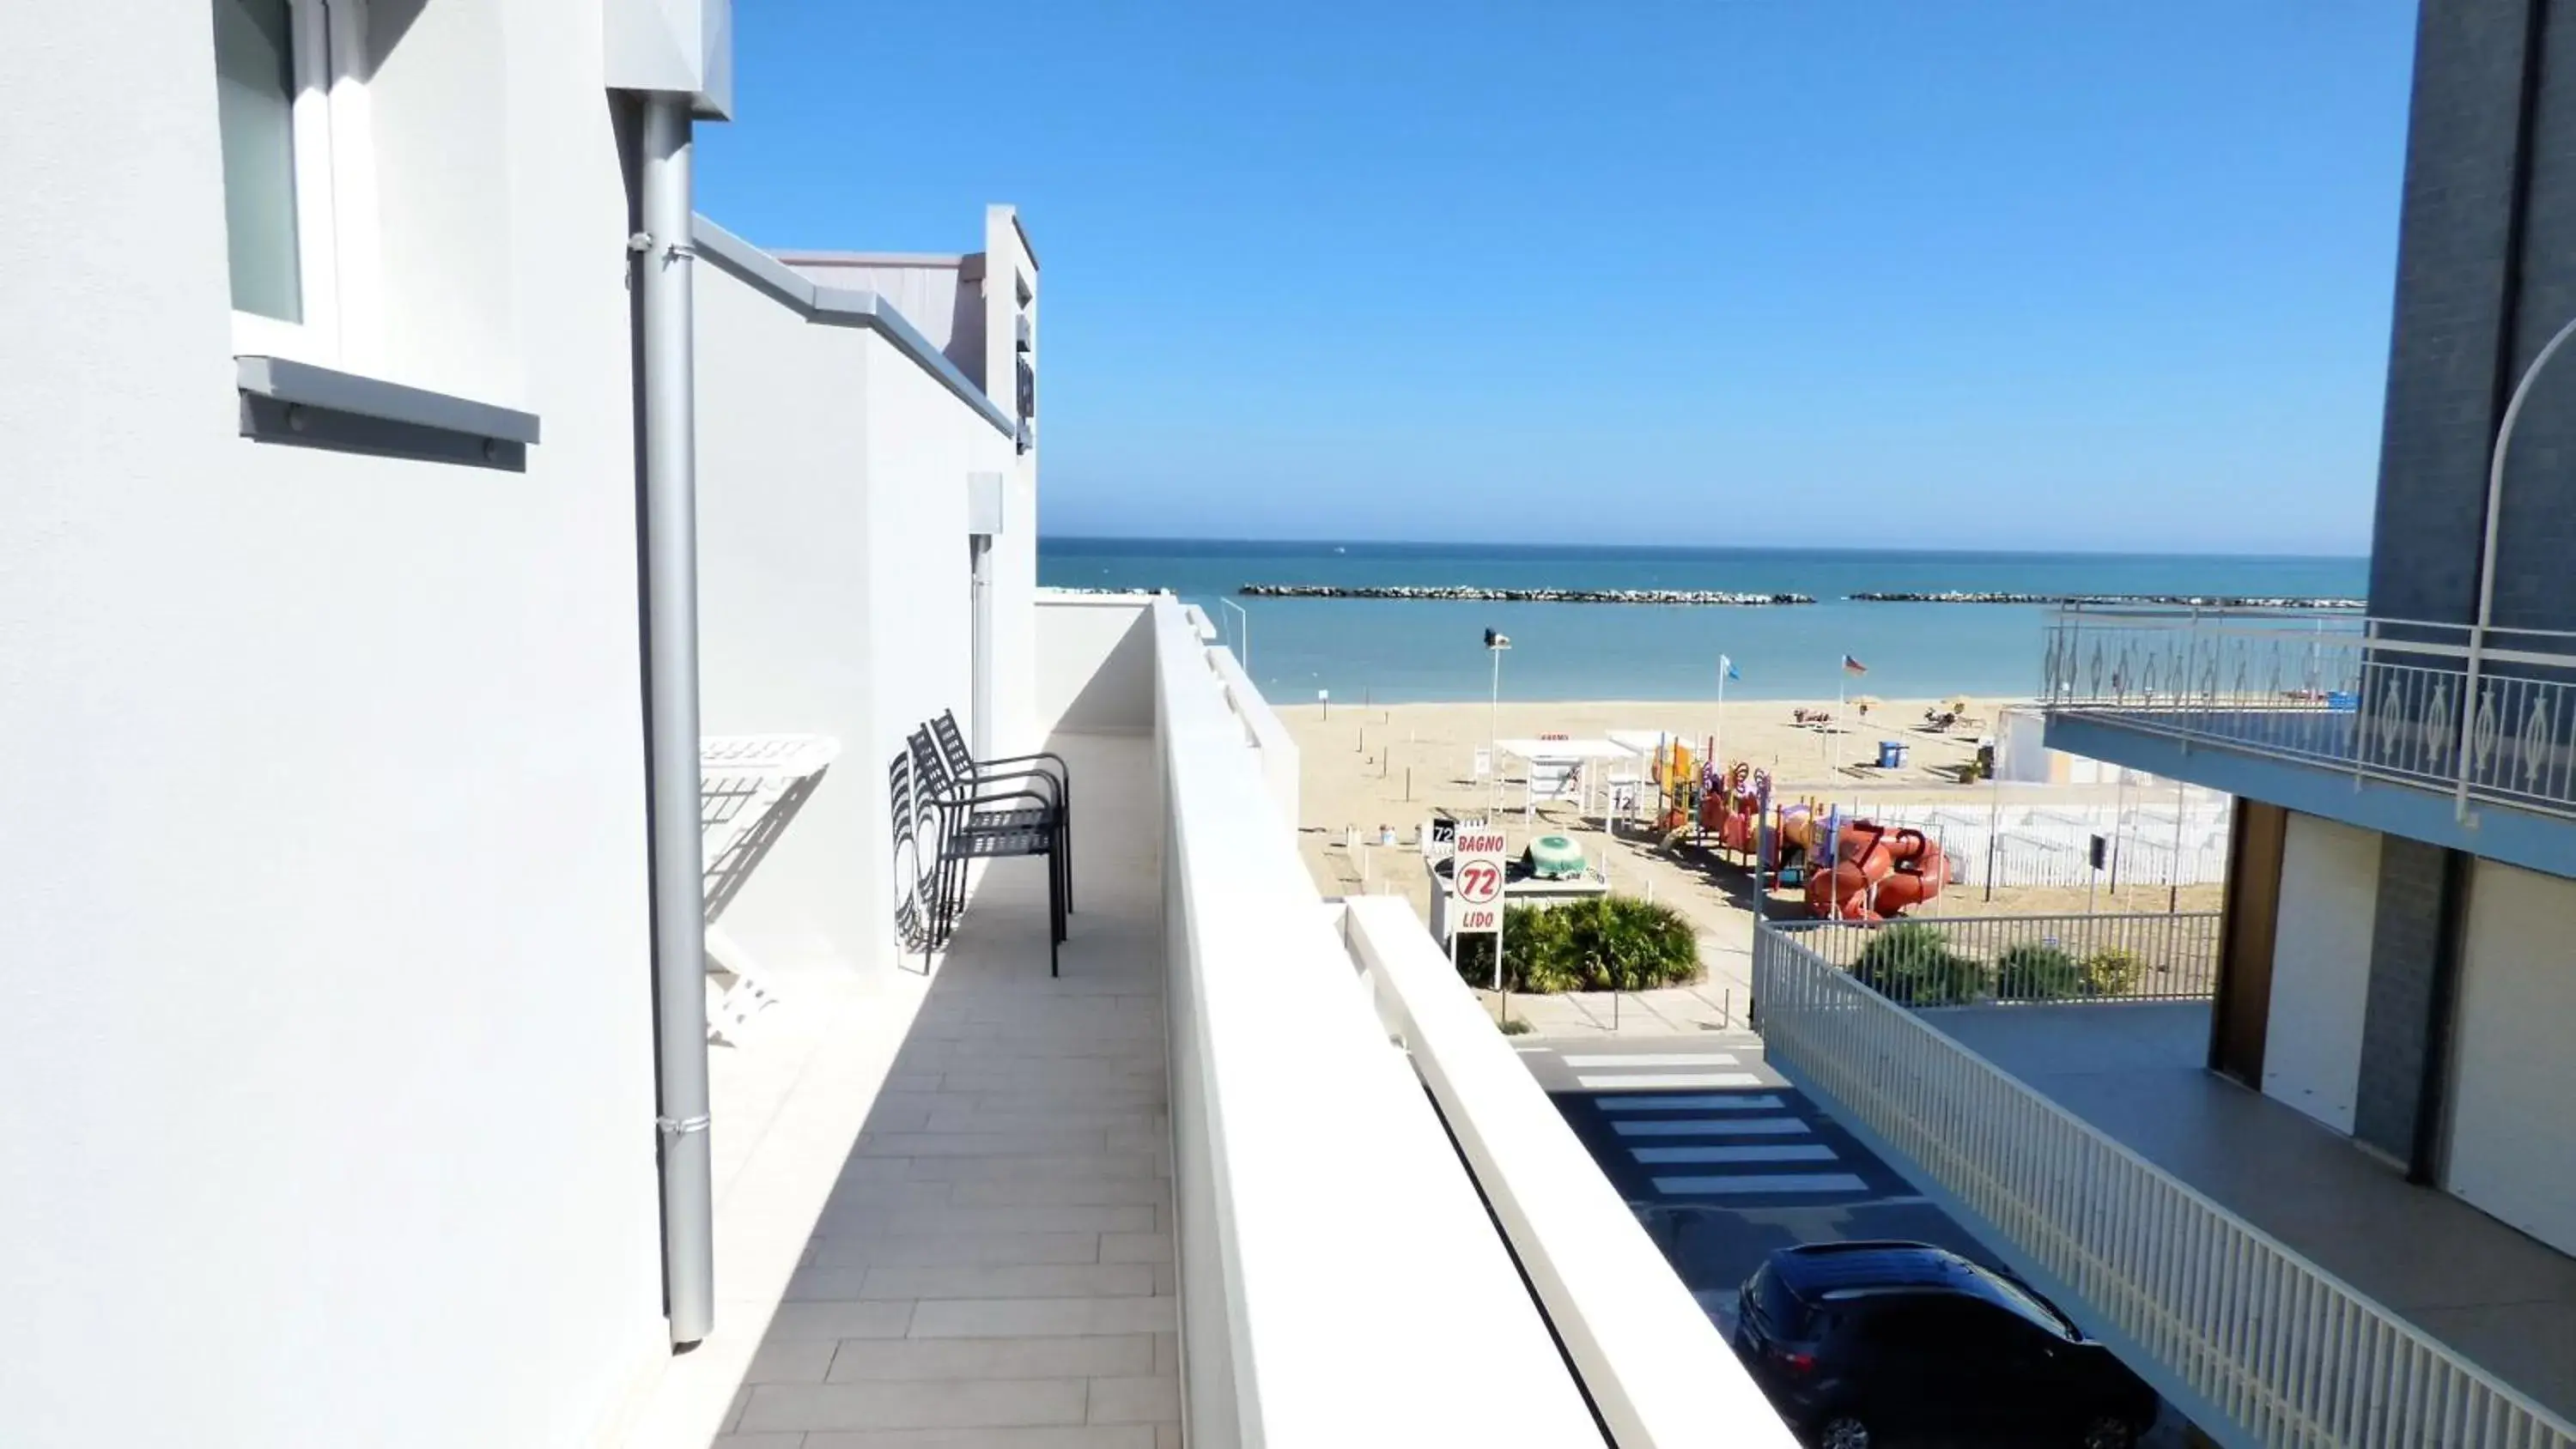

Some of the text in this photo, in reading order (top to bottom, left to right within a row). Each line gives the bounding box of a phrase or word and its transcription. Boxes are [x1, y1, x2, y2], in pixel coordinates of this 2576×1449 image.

[1435, 827, 1454, 842] 72
[1457, 834, 1504, 852] BAGNO
[1463, 868, 1497, 894] 72
[1462, 911, 1494, 928] LIDO
